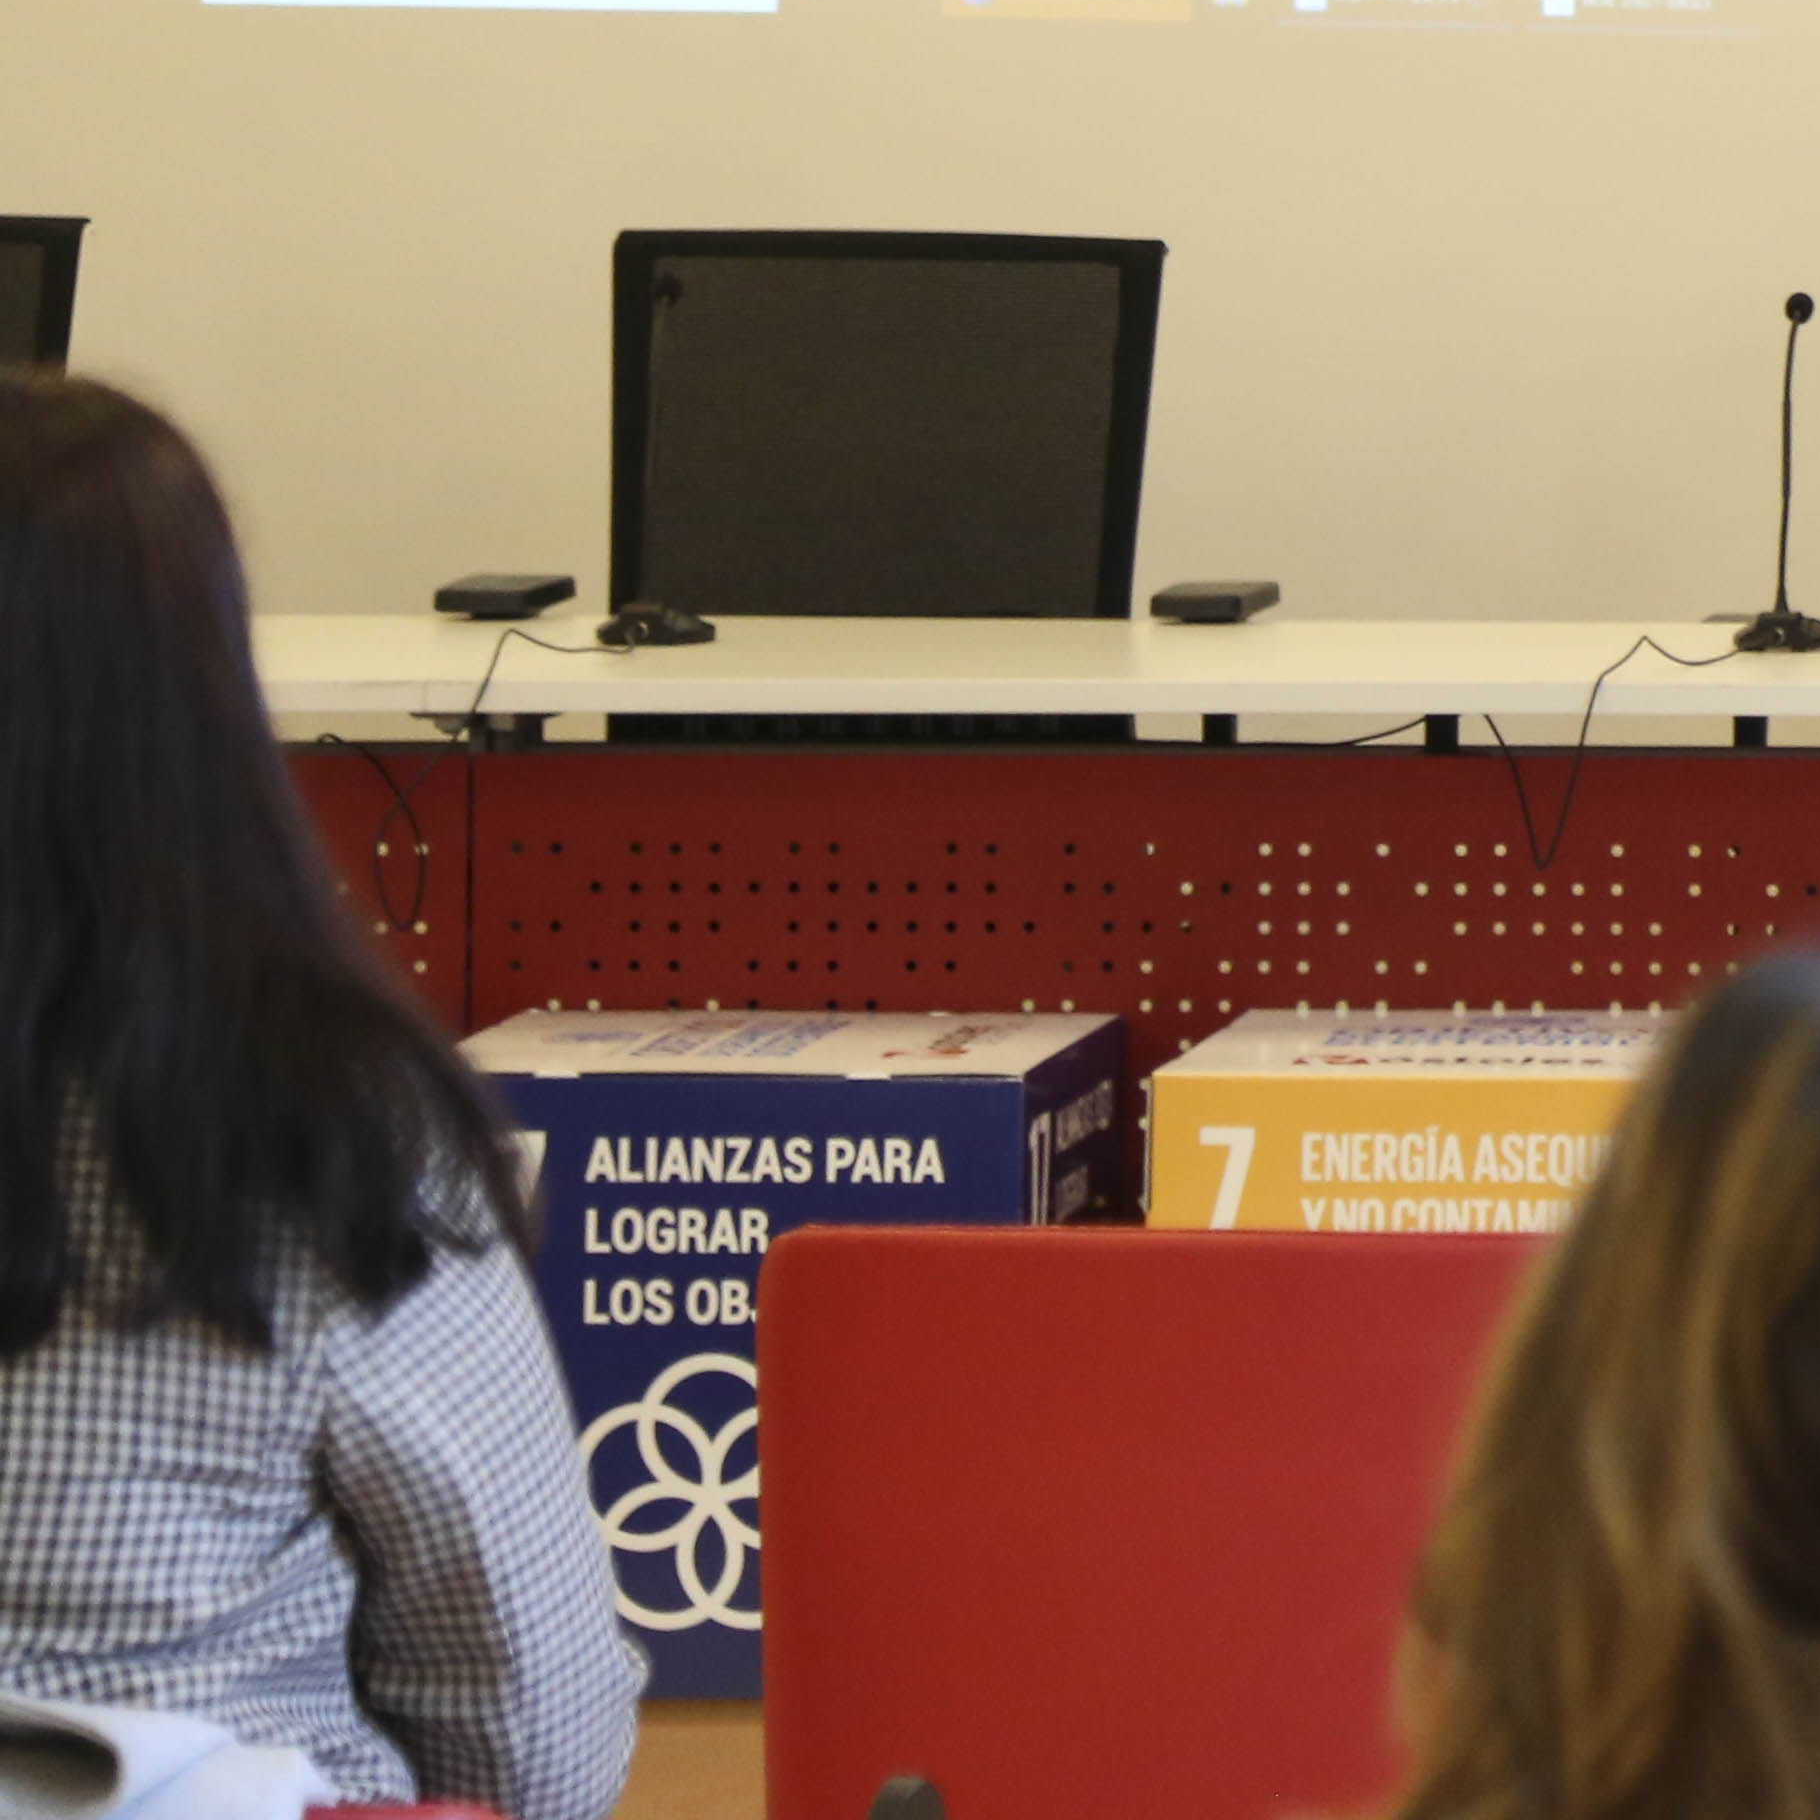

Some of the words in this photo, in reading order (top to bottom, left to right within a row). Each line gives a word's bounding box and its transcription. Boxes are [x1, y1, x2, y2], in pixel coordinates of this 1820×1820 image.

[584, 1136, 813, 1184] ALIANZAS
[825, 1138, 945, 1184] PARA
[1199, 1126, 1256, 1230] 7
[1302, 1126, 1465, 1185] ENERGÍA
[584, 1207, 770, 1255] LOGRAR
[1302, 1199, 1325, 1232] Y
[1333, 1199, 1386, 1233] NO
[583, 1278, 674, 1326] LOS
[684, 1278, 758, 1326] OB
